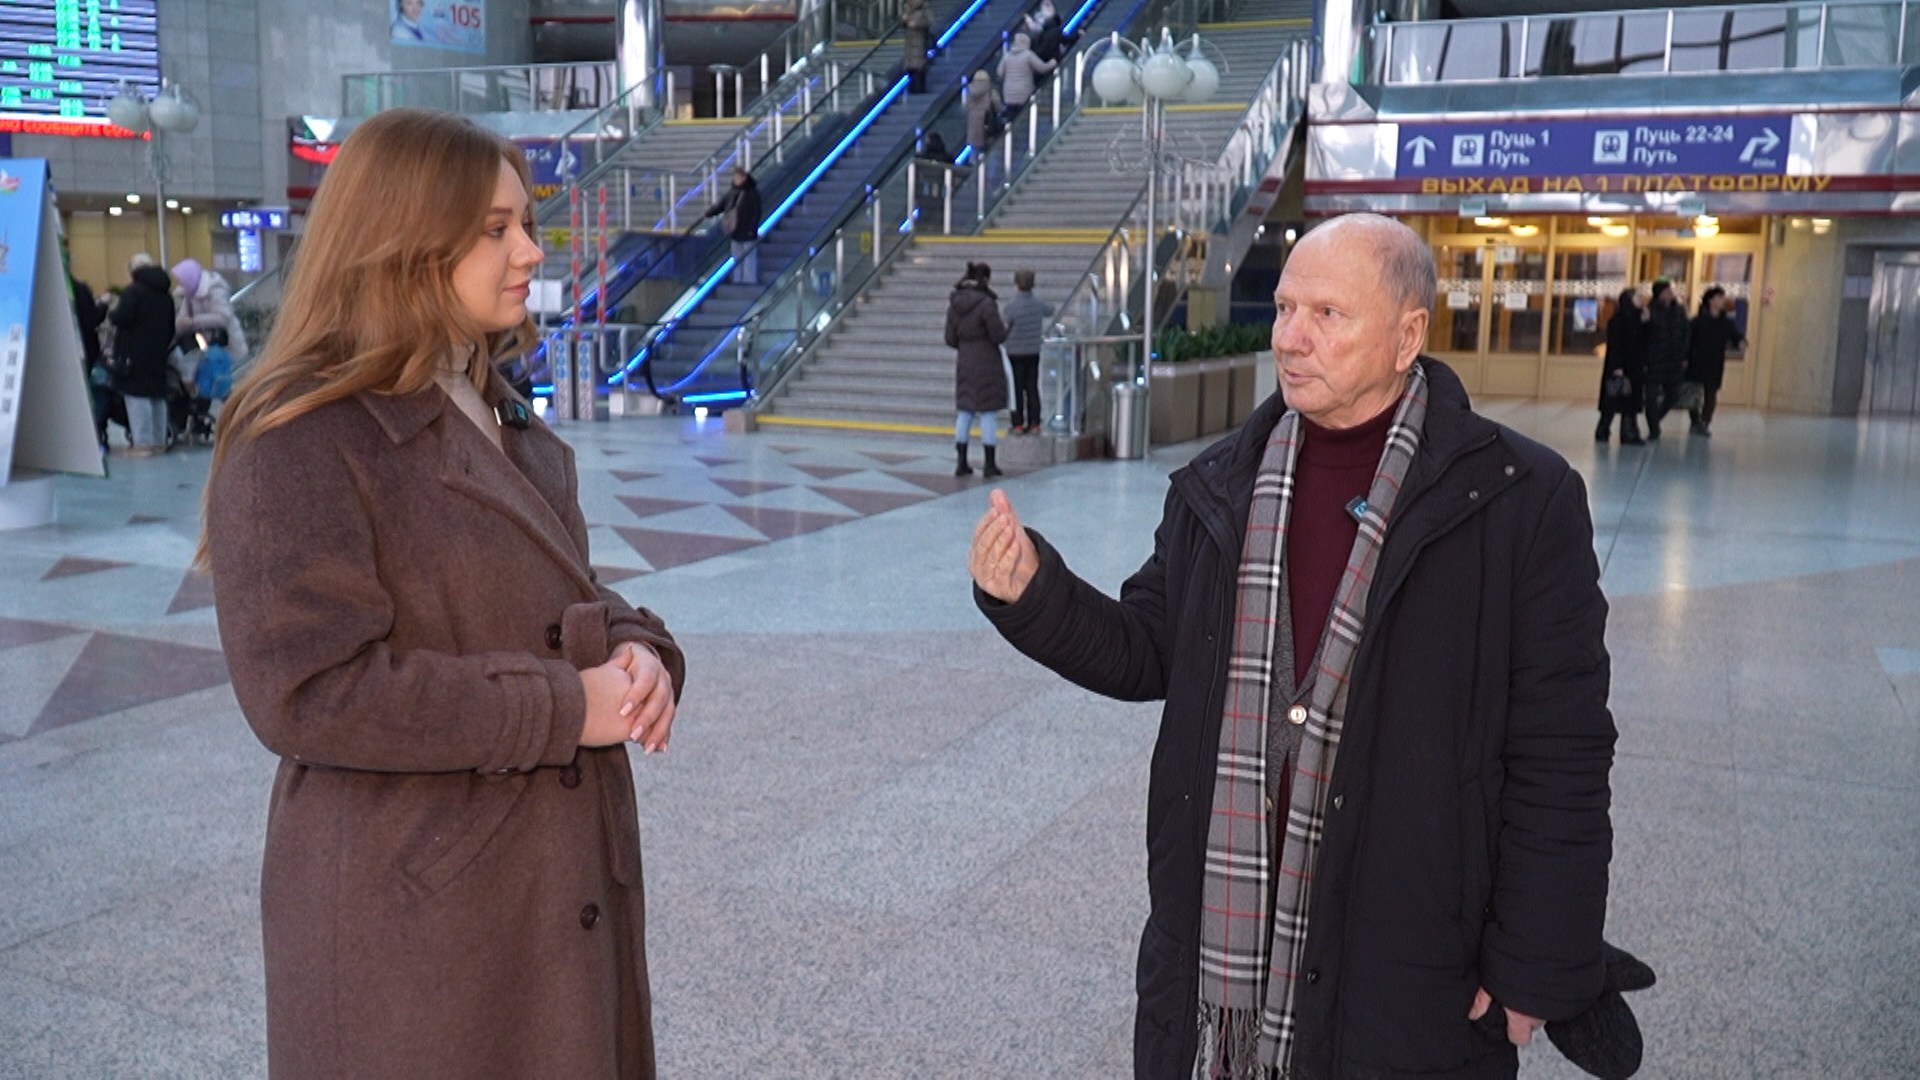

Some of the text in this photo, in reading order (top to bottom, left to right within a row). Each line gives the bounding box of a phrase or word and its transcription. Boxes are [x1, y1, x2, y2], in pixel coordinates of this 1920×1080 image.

[449, 3, 481, 28] 105
[1490, 129, 1550, 148] Пуць 1
[1634, 125, 1735, 145] Пуць 22-24
[1489, 148, 1531, 168] Путь
[1633, 146, 1678, 165] Путь
[1421, 175, 1832, 194] ВЫХАД НА 1 ПЛАТФОРМУ
